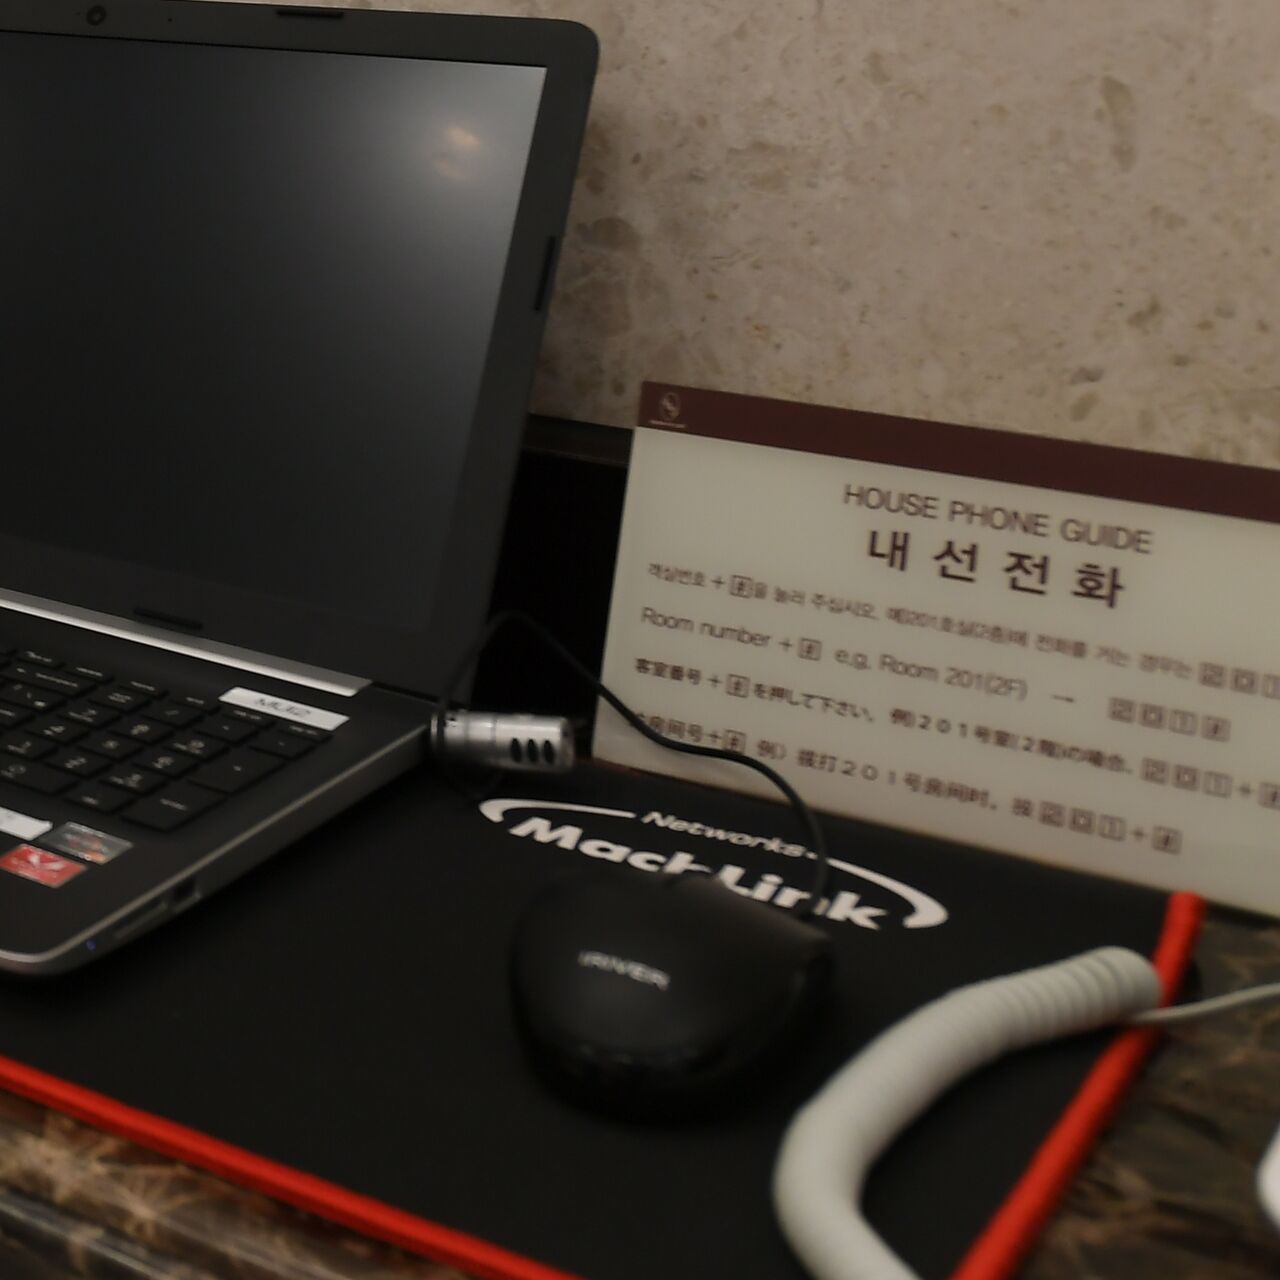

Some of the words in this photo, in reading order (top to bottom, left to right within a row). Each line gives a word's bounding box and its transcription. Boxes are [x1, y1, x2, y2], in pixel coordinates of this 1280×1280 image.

[844, 484, 938, 520] HOUSE
[948, 500, 1051, 538] PHONE
[1059, 518, 1154, 555] GUIDE
[641, 606, 694, 633] Room
[699, 621, 771, 648] number
[834, 649, 872, 671] e.g.
[879, 653, 939, 682] Room
[945, 667, 1028, 701] 201(2F)
[641, 810, 808, 859] Networks
